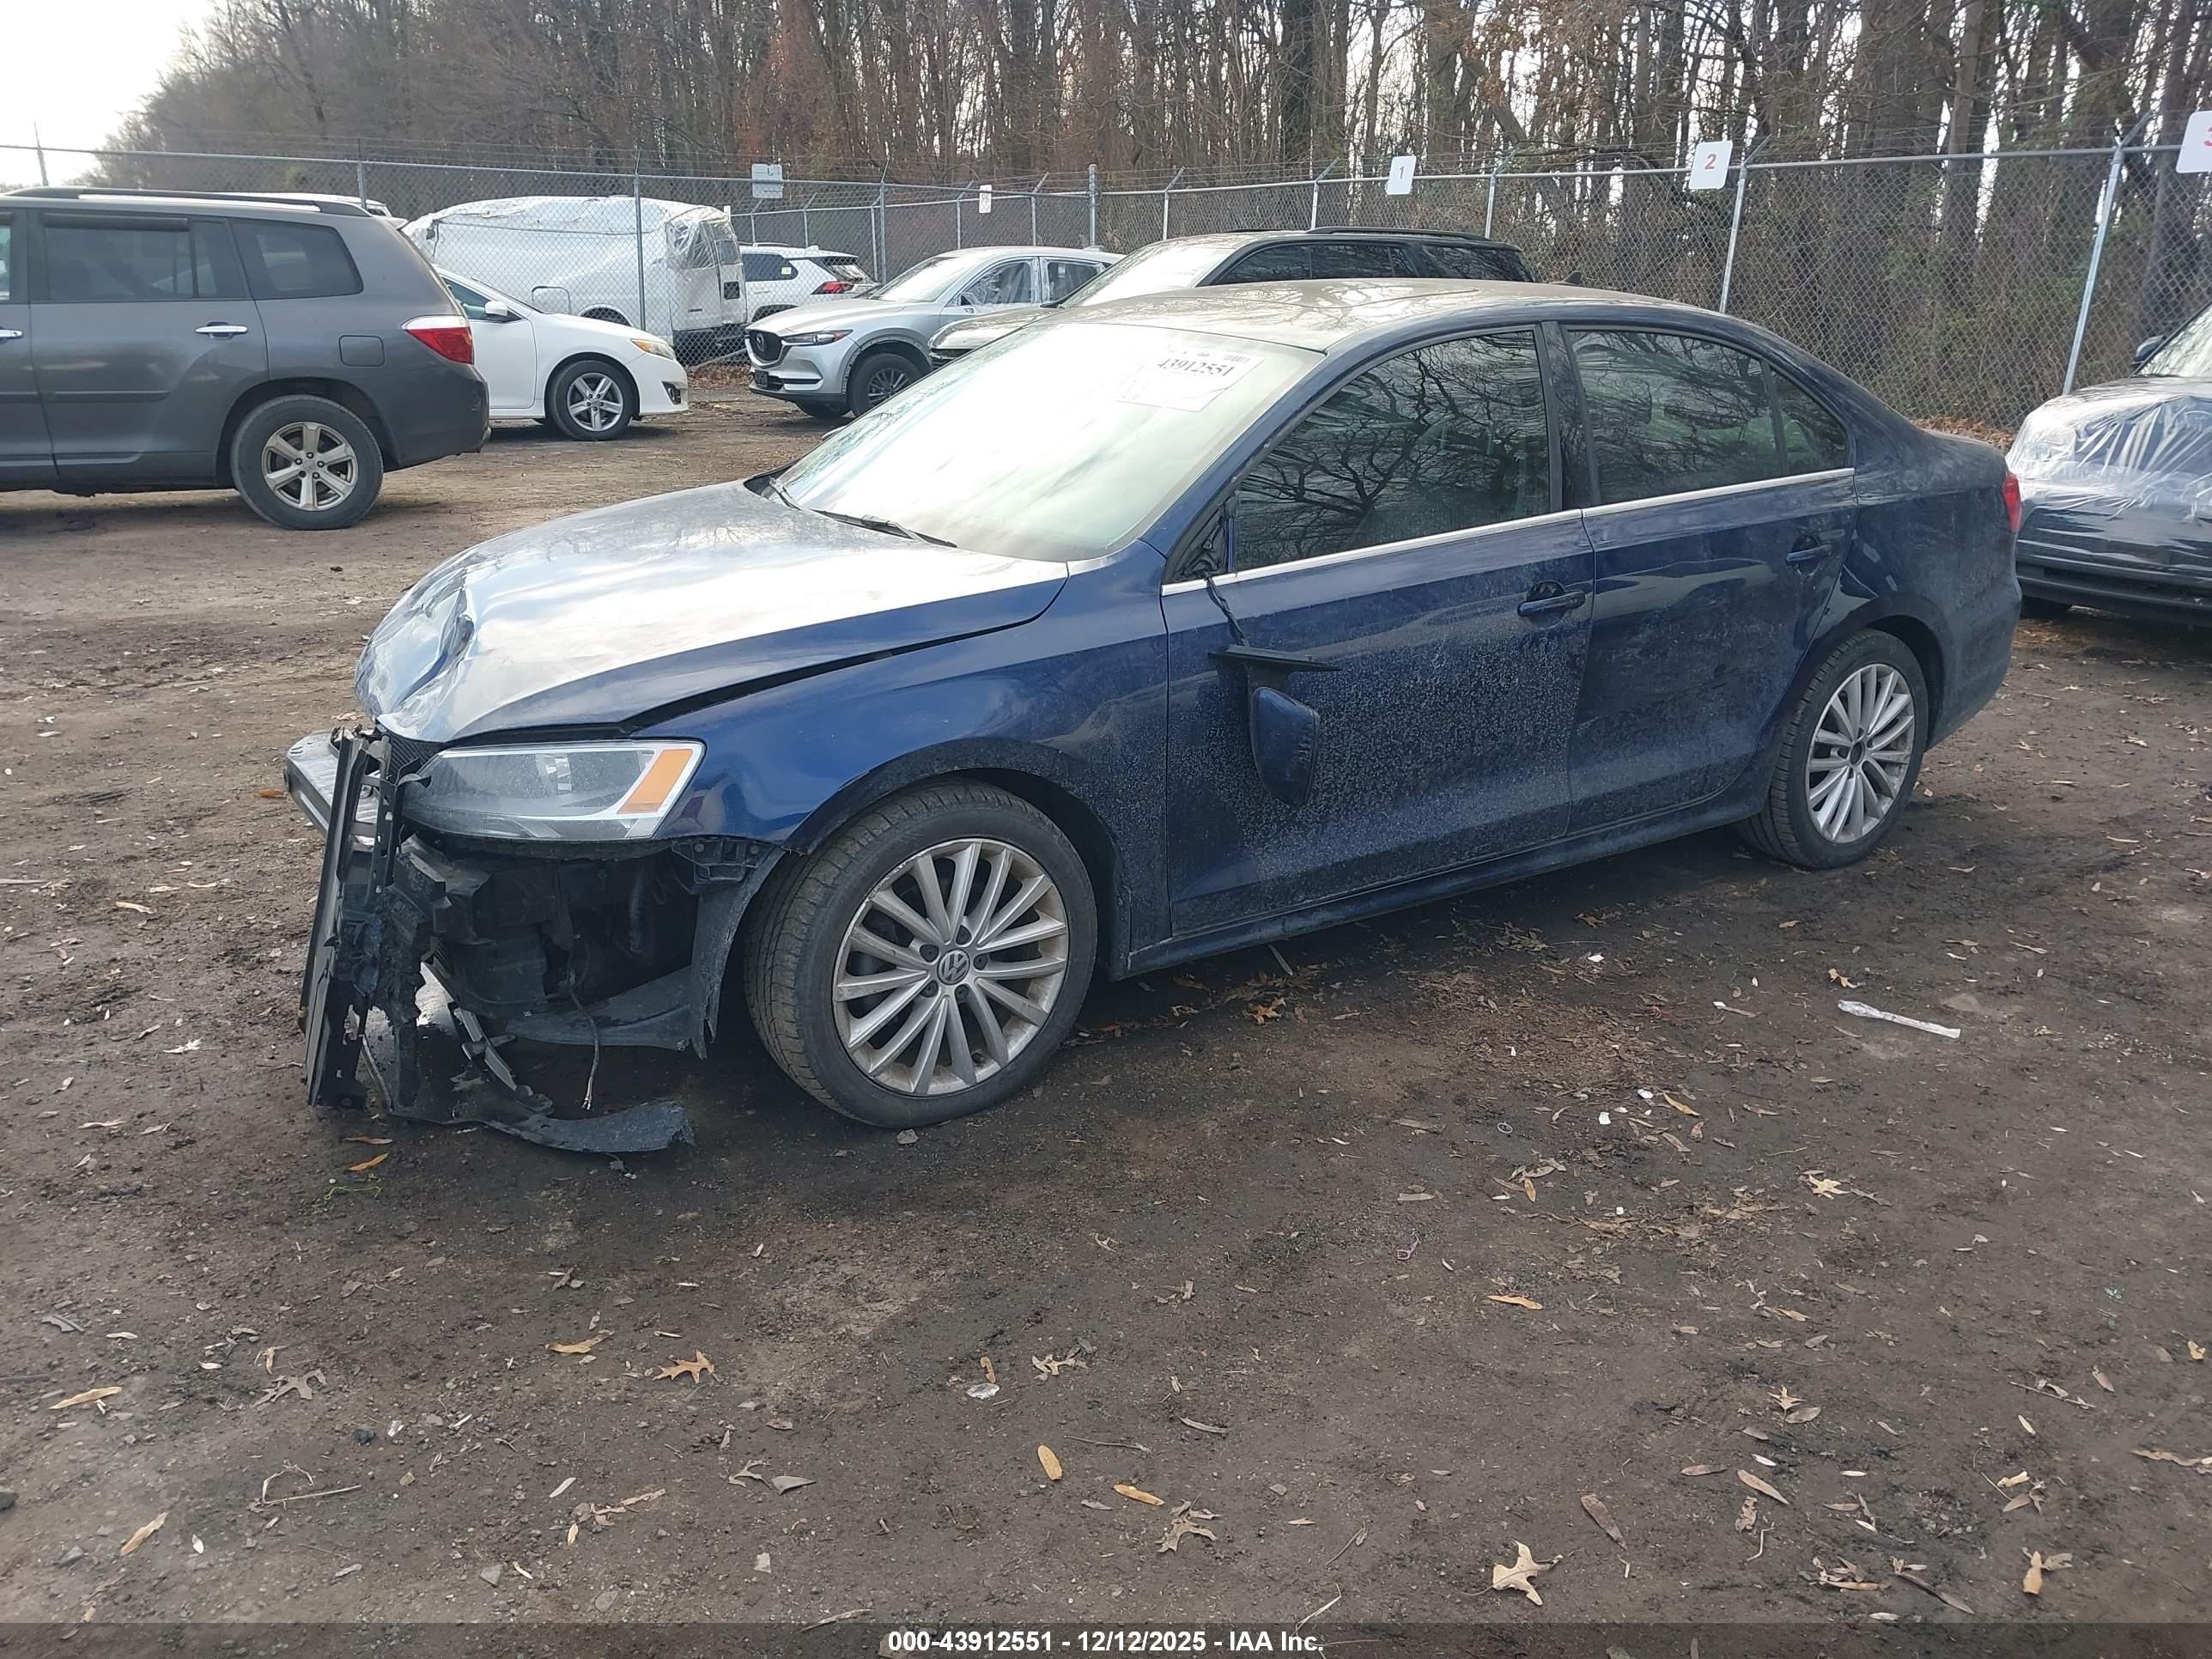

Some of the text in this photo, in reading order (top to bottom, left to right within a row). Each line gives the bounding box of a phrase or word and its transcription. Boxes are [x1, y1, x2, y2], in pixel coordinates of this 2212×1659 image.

[1704, 153, 1717, 170] 2
[1399, 165, 1405, 179] 1
[1157, 358, 1235, 376] 43912551
